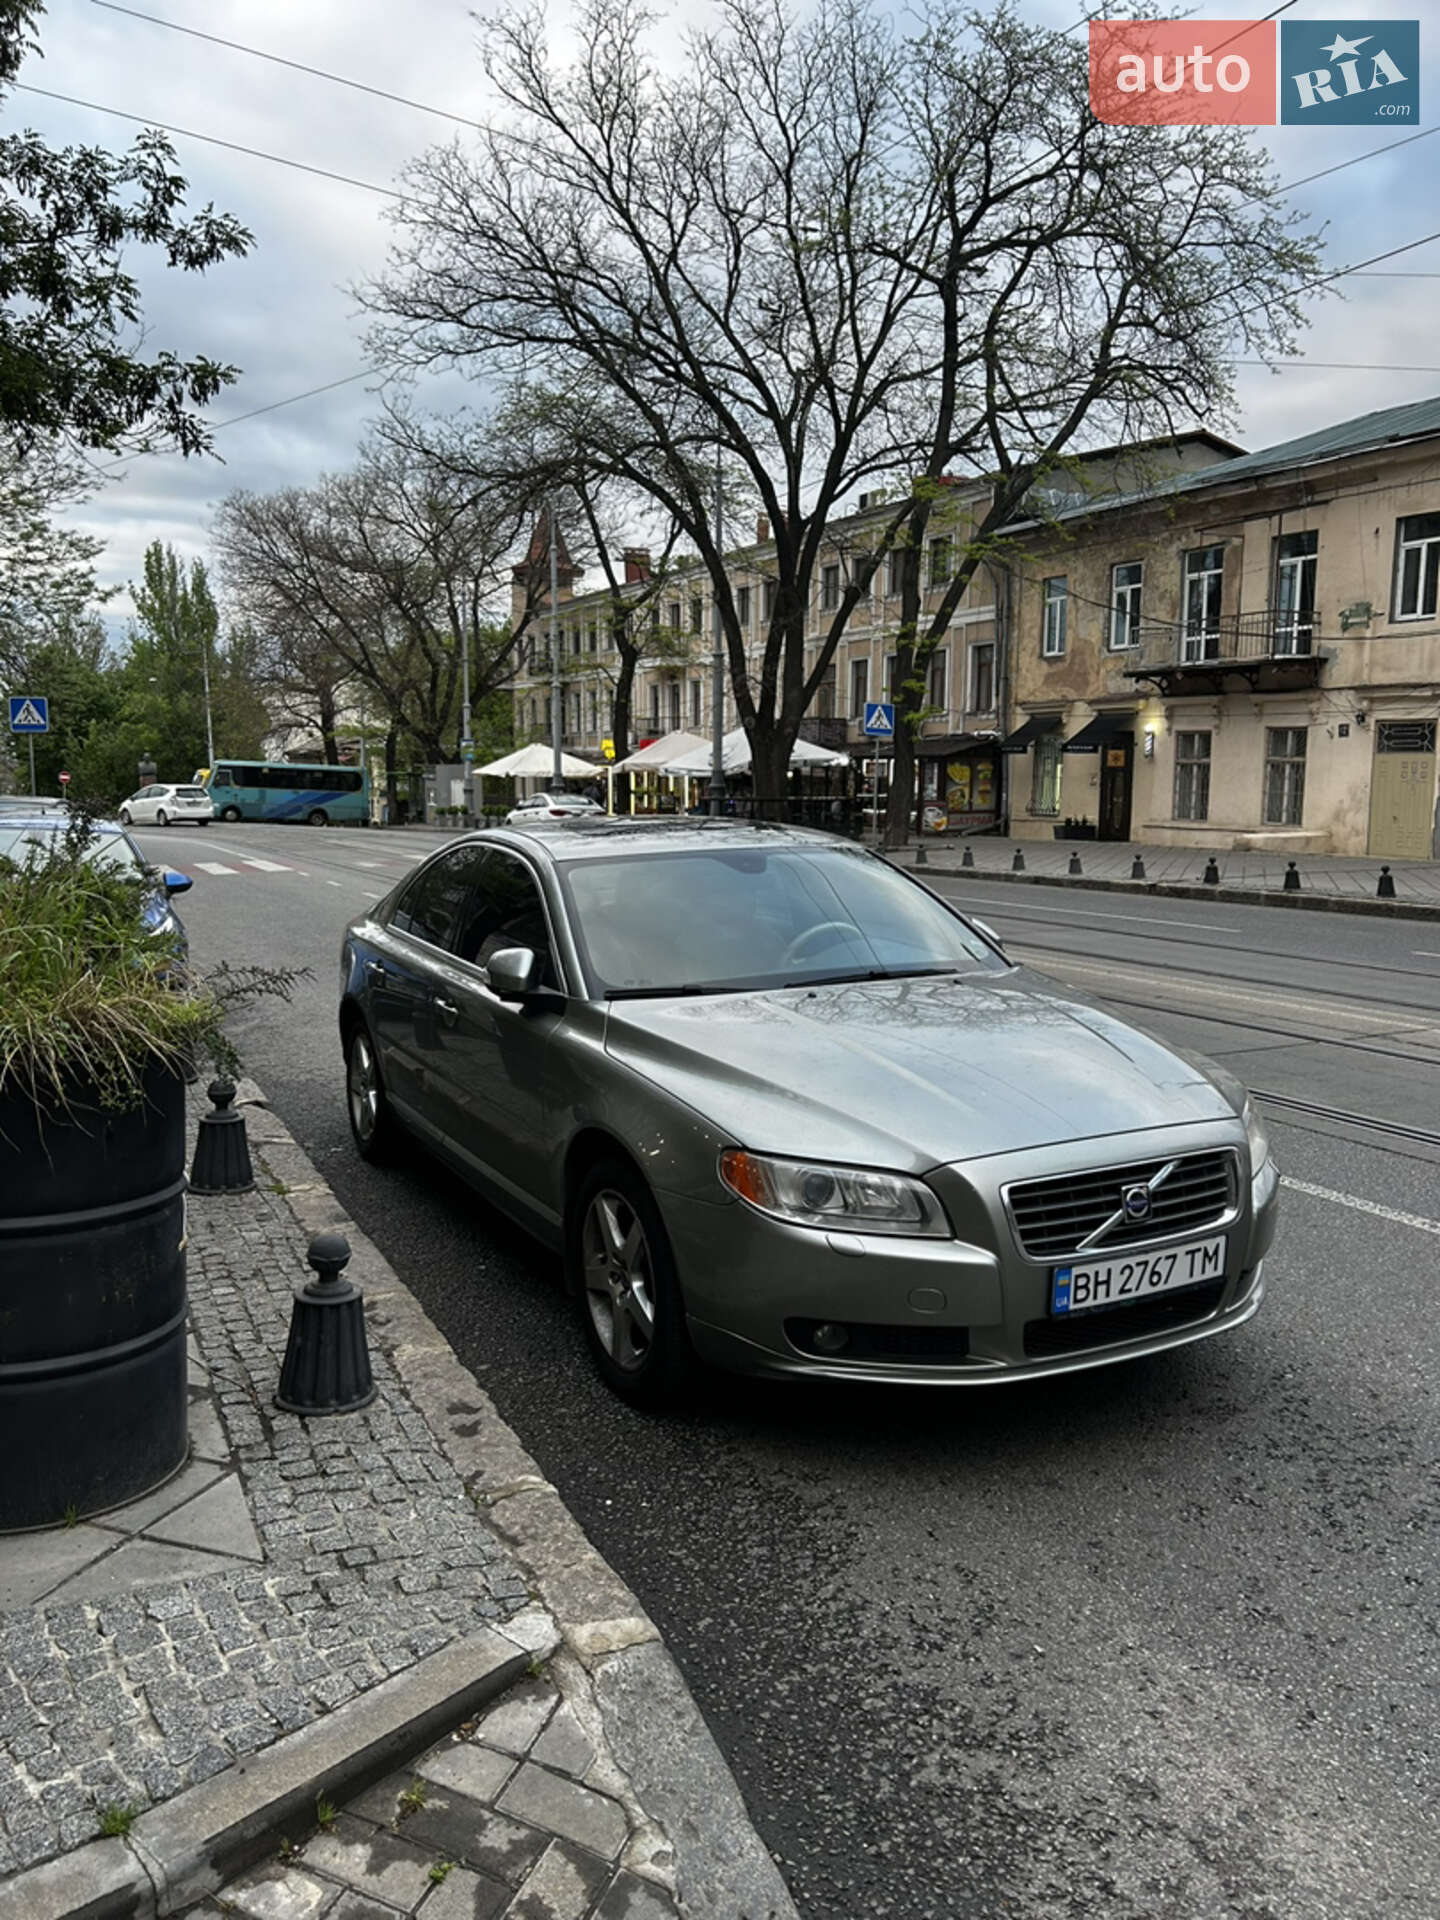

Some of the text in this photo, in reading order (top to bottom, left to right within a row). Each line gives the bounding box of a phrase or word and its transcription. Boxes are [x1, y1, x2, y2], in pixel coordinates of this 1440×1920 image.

[1072, 1242, 1220, 1305] BH 2767 TM
